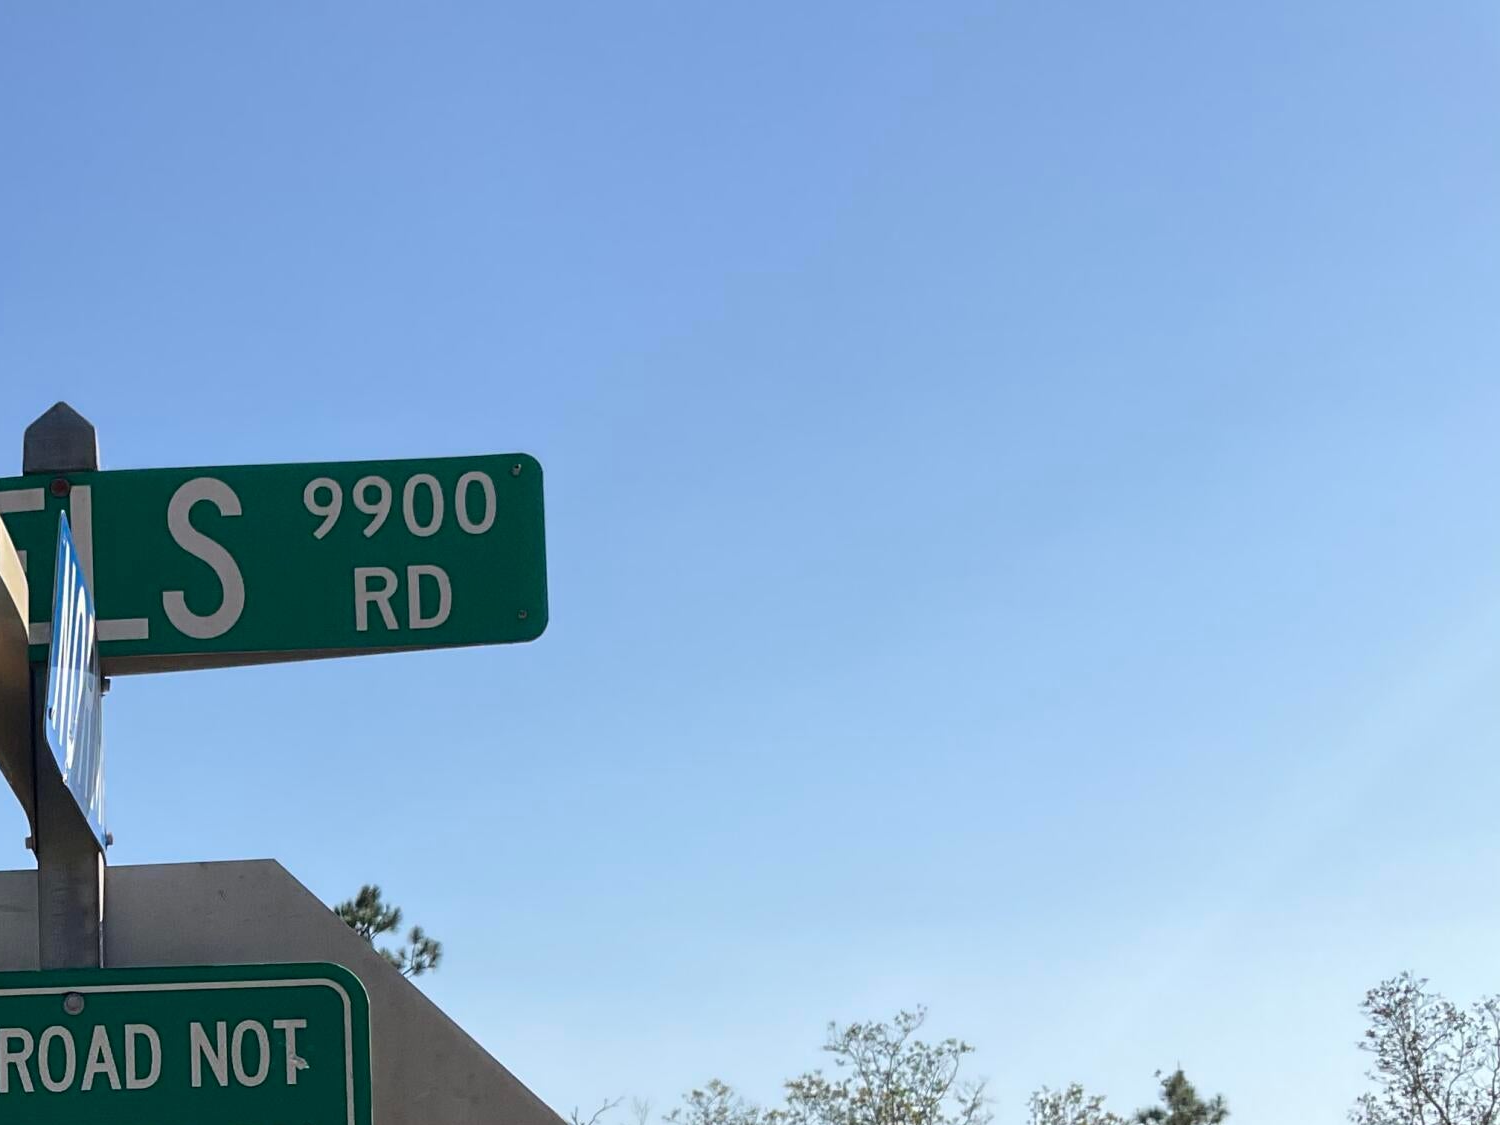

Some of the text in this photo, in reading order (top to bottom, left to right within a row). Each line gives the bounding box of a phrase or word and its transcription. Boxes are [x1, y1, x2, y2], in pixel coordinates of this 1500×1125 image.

[303, 471, 498, 541] 9900
[354, 565, 453, 632] RD
[190, 1018, 307, 1088] NOT
